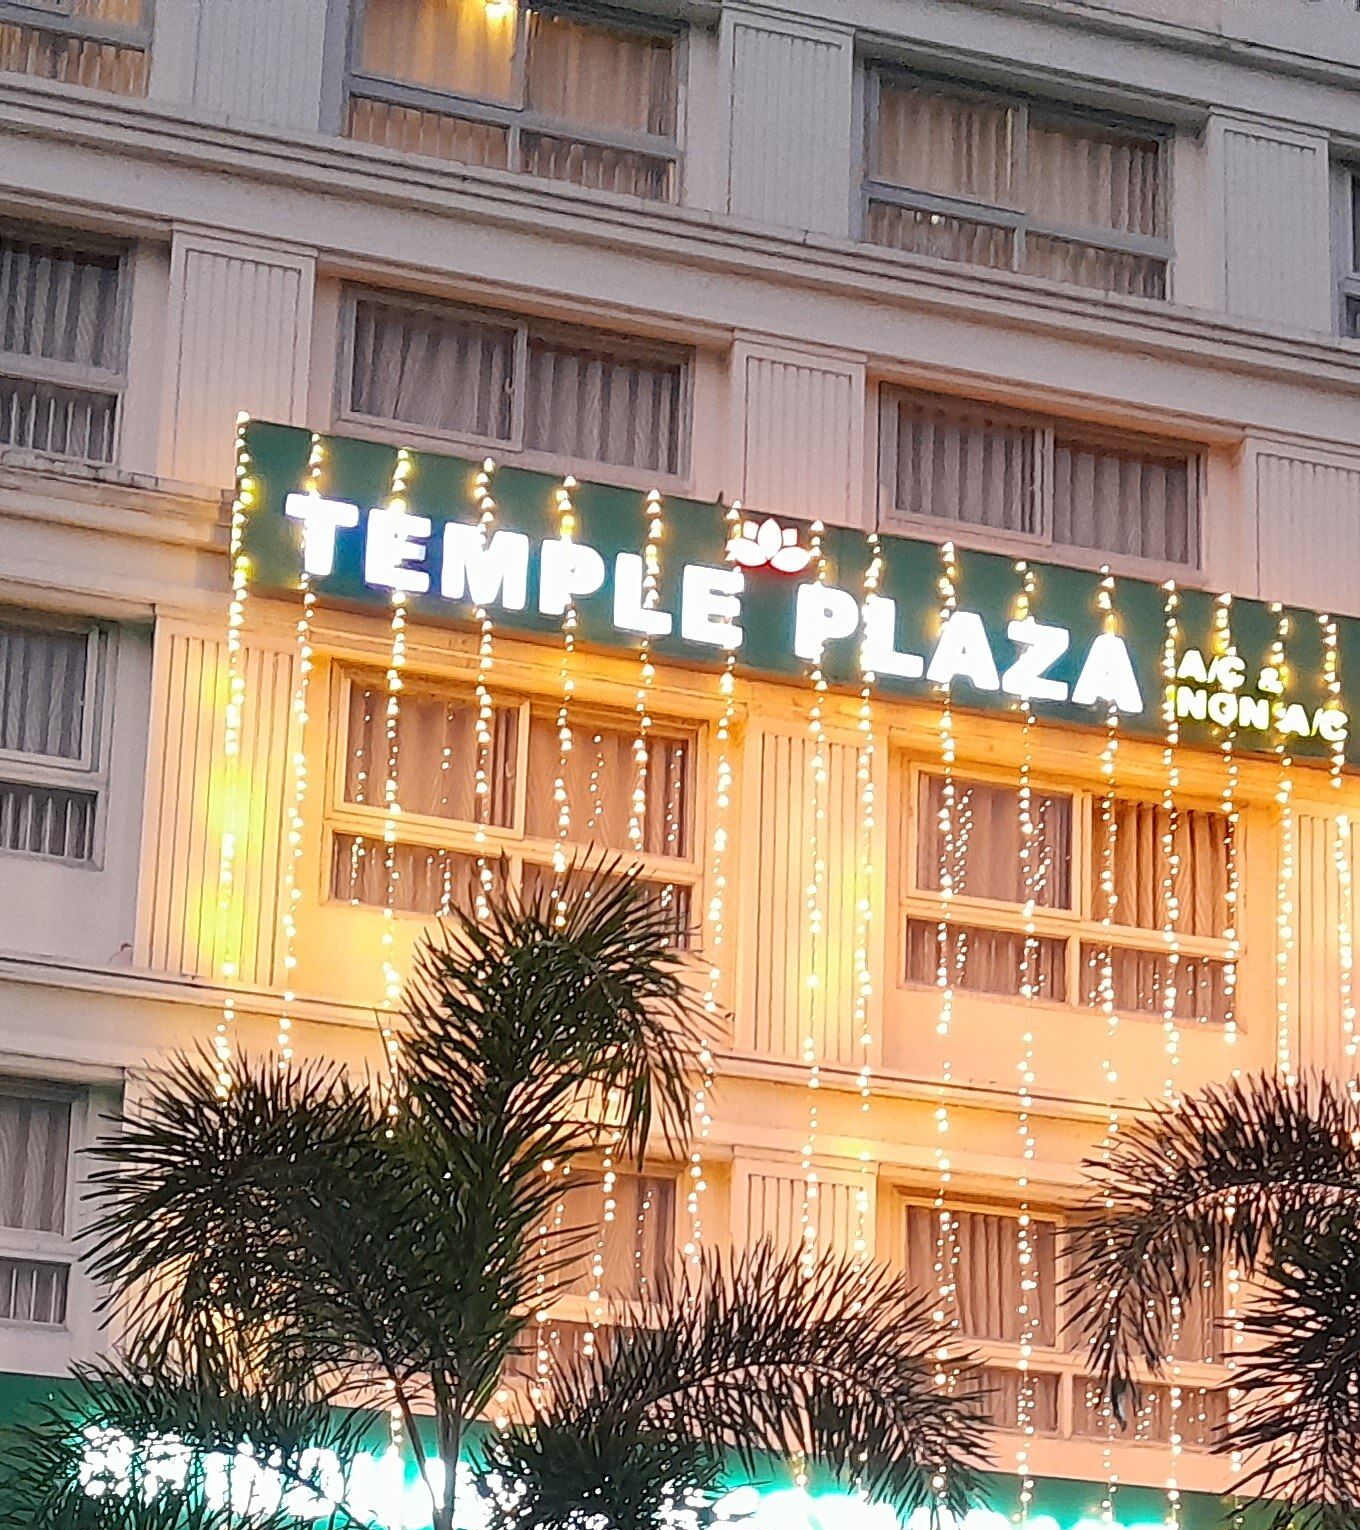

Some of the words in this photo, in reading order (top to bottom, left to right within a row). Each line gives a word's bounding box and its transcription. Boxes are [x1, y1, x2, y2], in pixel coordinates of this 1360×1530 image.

[285, 493, 744, 649] TEMPLE
[794, 582, 1143, 713] PLAZA
[1177, 650, 1245, 688] A/C
[1258, 667, 1284, 694] &
[1176, 686, 1270, 729] NON
[1283, 704, 1348, 742] A/C
